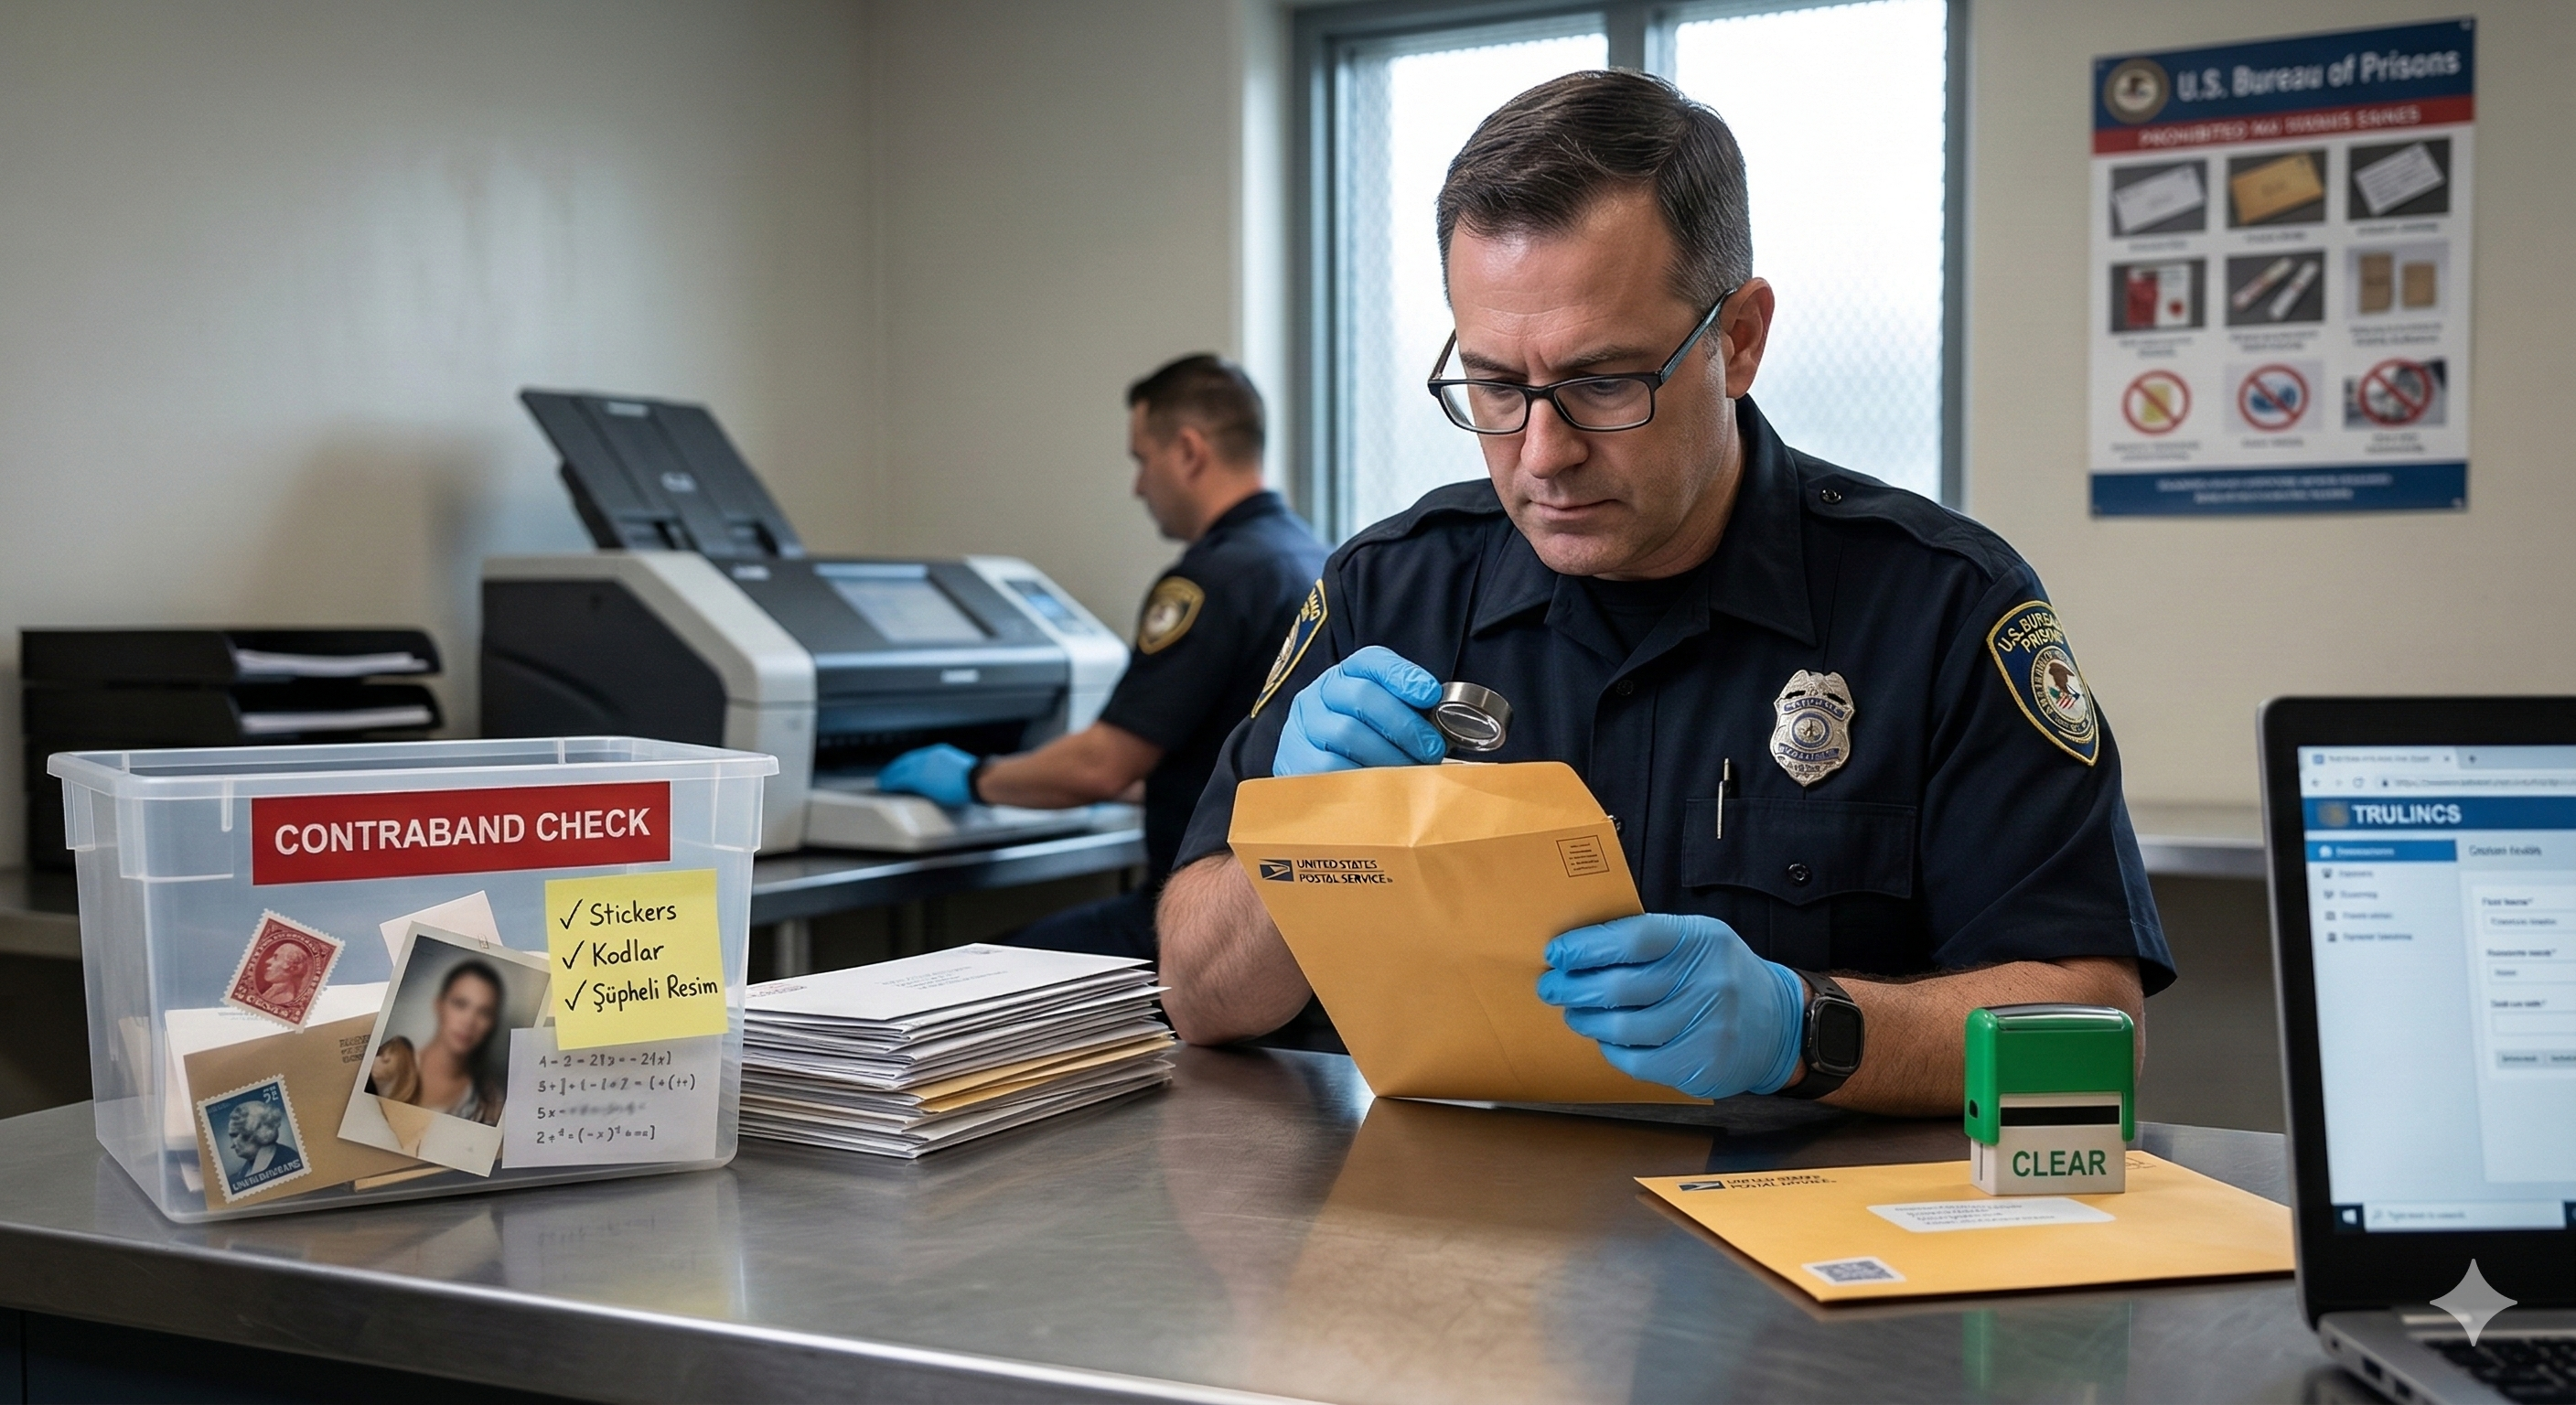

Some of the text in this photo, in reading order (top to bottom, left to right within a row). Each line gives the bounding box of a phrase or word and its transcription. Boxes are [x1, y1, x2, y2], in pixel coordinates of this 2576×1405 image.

[2177, 49, 2461, 102] U.S. Bureau of Prisons
[2352, 803, 2462, 824] TRULINCS
[275, 808, 650, 855] CONTRABAND CHECK
[1296, 859, 1378, 869] UNITED STATES
[1300, 874, 1339, 884] POSTAL
[590, 900, 677, 927] Stickers
[593, 938, 665, 967] Kodlar
[593, 978, 659, 1013] Şüpheli
[667, 974, 718, 998] Resim
[2012, 1150, 2107, 1177] CLEAR
